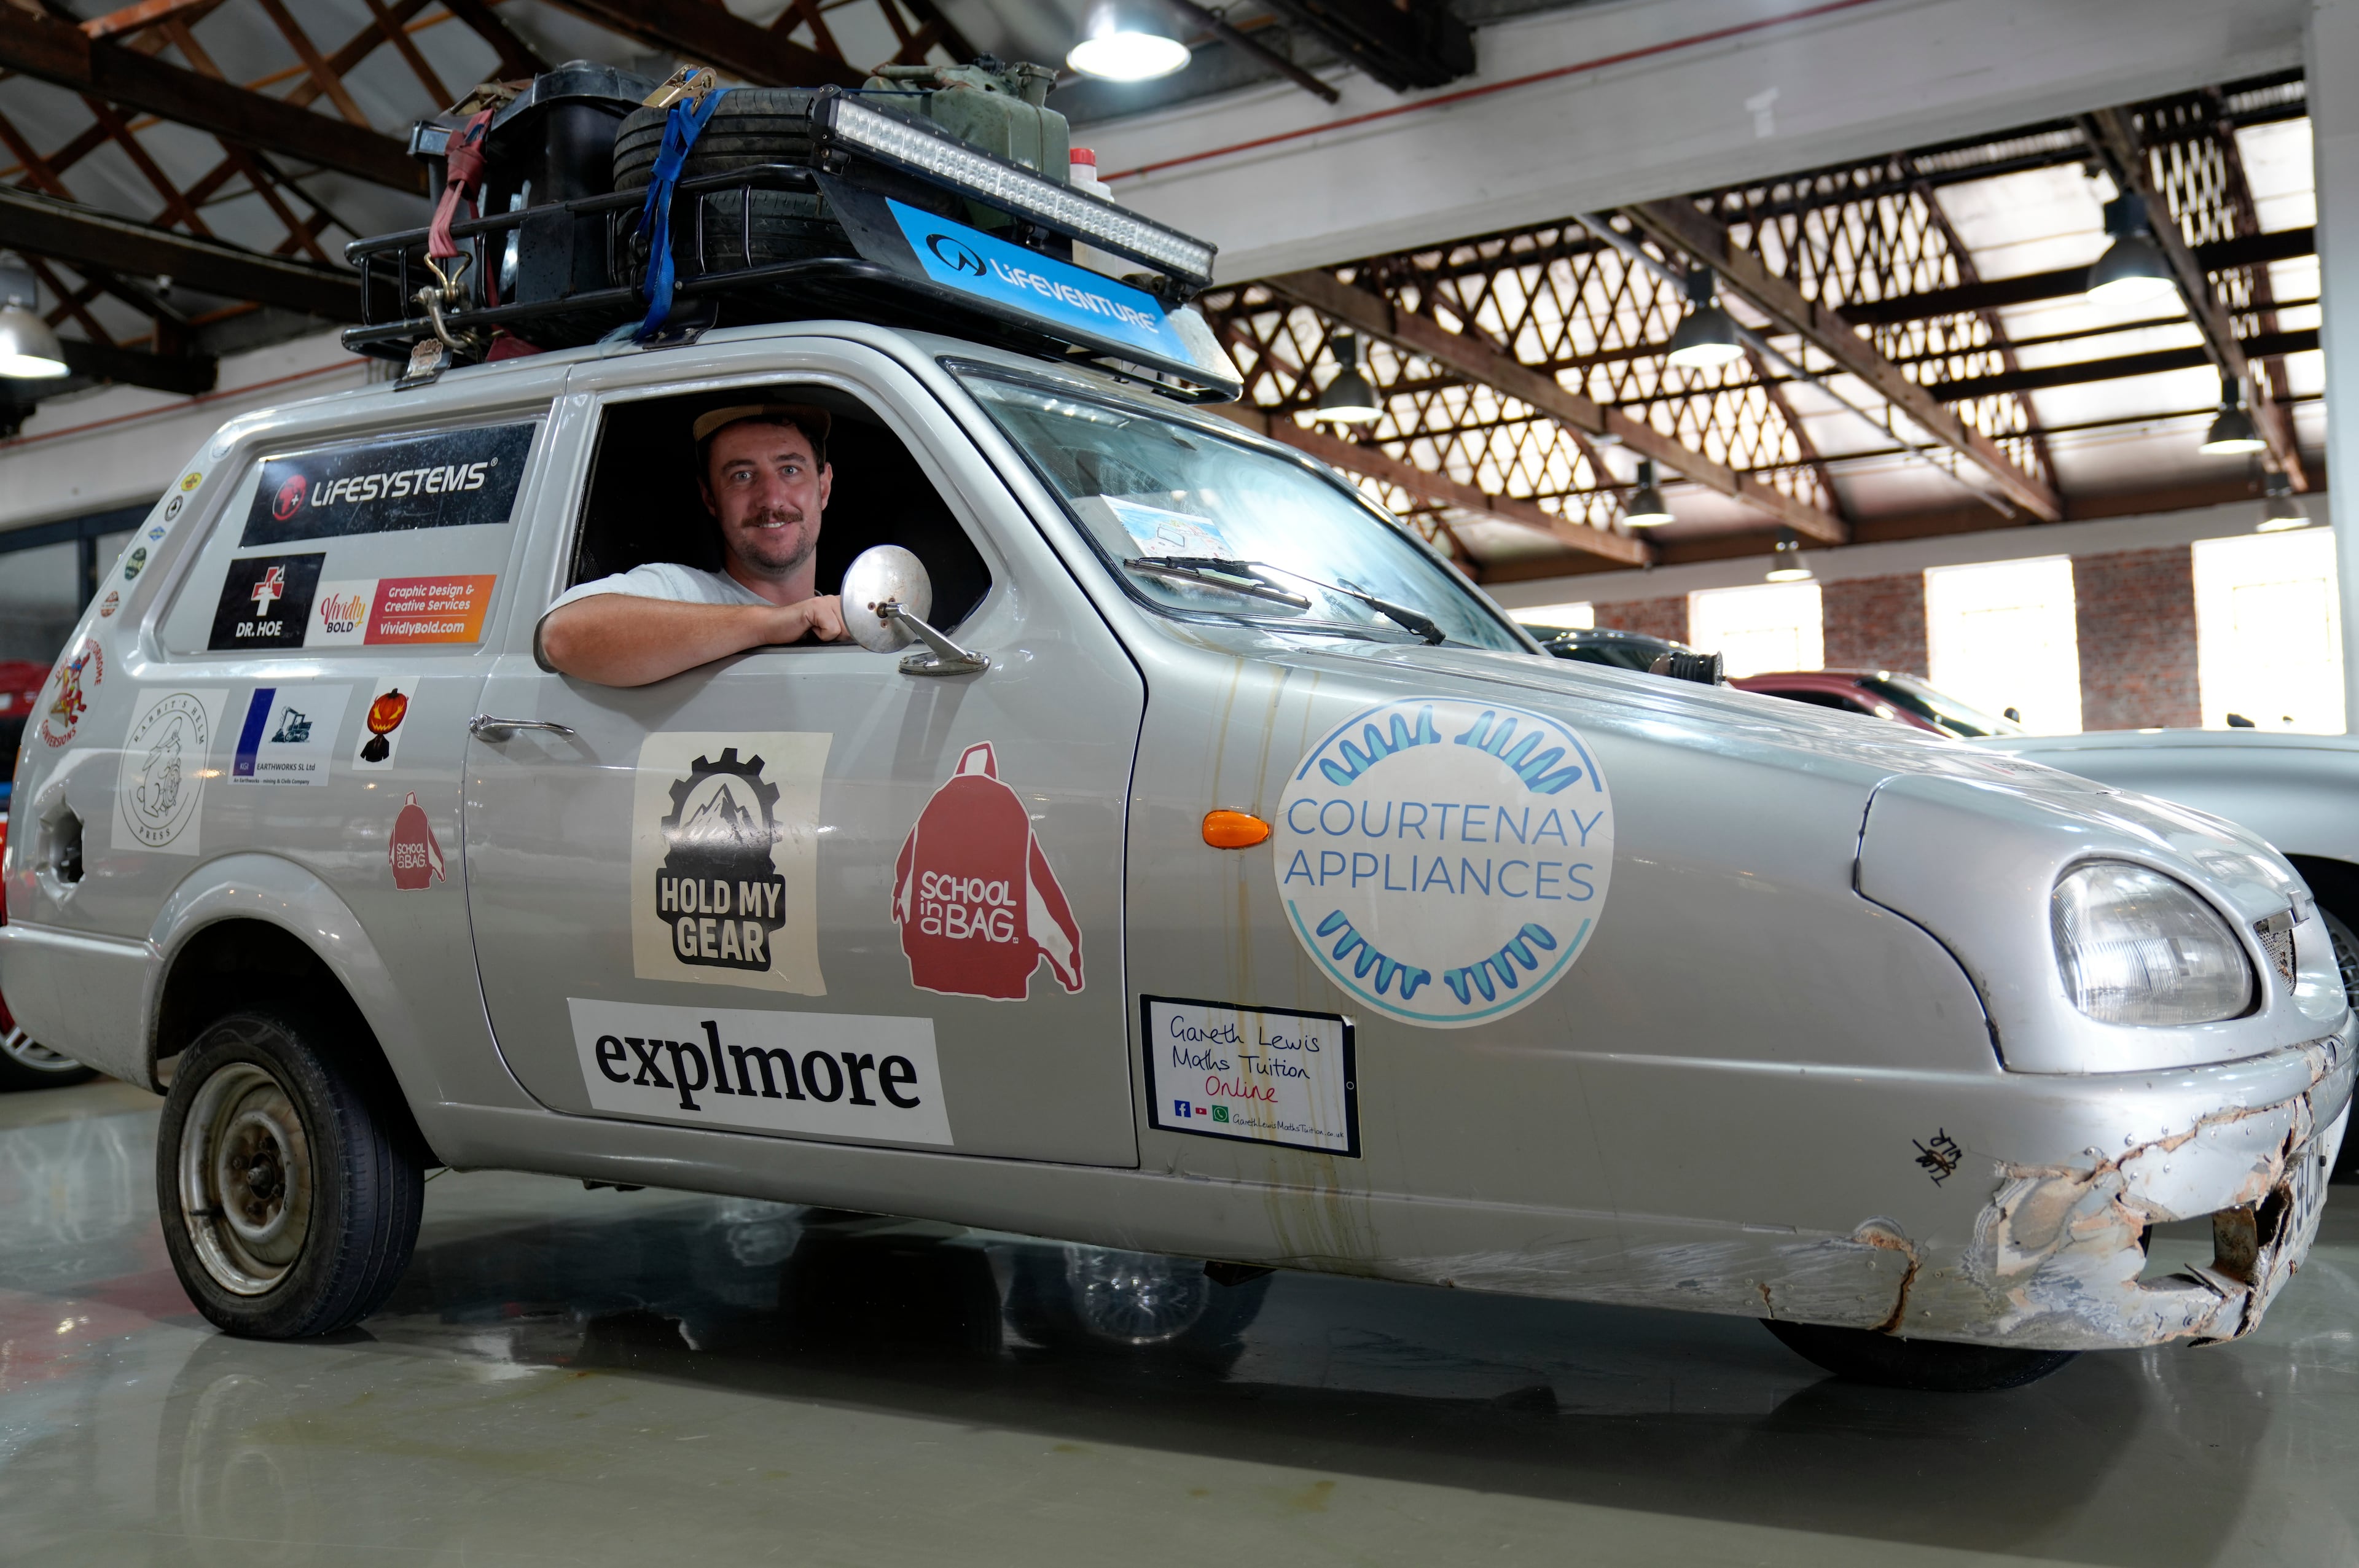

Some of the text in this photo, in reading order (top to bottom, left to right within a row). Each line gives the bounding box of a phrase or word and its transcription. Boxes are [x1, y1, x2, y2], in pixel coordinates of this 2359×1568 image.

[385, 598, 471, 612] Creative Services
[388, 583, 474, 599] Graphic Design &
[320, 593, 366, 628] Vividly
[235, 620, 283, 637] DR. HOE
[326, 622, 354, 633] BOLD
[380, 620, 464, 637] VividlyBold.com
[82, 638, 104, 687] MOTORHOME
[41, 719, 77, 749] CONVERSIONS
[191, 706, 205, 745] HELM
[139, 826, 171, 841] PRESS
[1287, 798, 1604, 848] COURTENAY
[397, 842, 426, 855] SCHOOL
[397, 853, 404, 862] in
[405, 854, 426, 869] BAG
[920, 870, 1017, 907] SCHOOL
[1283, 849, 1595, 902] APPLIANCES
[661, 877, 782, 918] HOLD MY
[920, 897, 943, 918] in
[920, 903, 1014, 943] a BAG
[676, 916, 767, 963] GEAR
[1170, 1015, 1320, 1053] Gareth Lewis
[595, 1020, 921, 1112] explmore
[1172, 1045, 1310, 1080] Maths Tuition
[1205, 1075, 1279, 1103] Online
[1232, 1114, 1345, 1138] GarethLewisMathsTuition.co.uk
